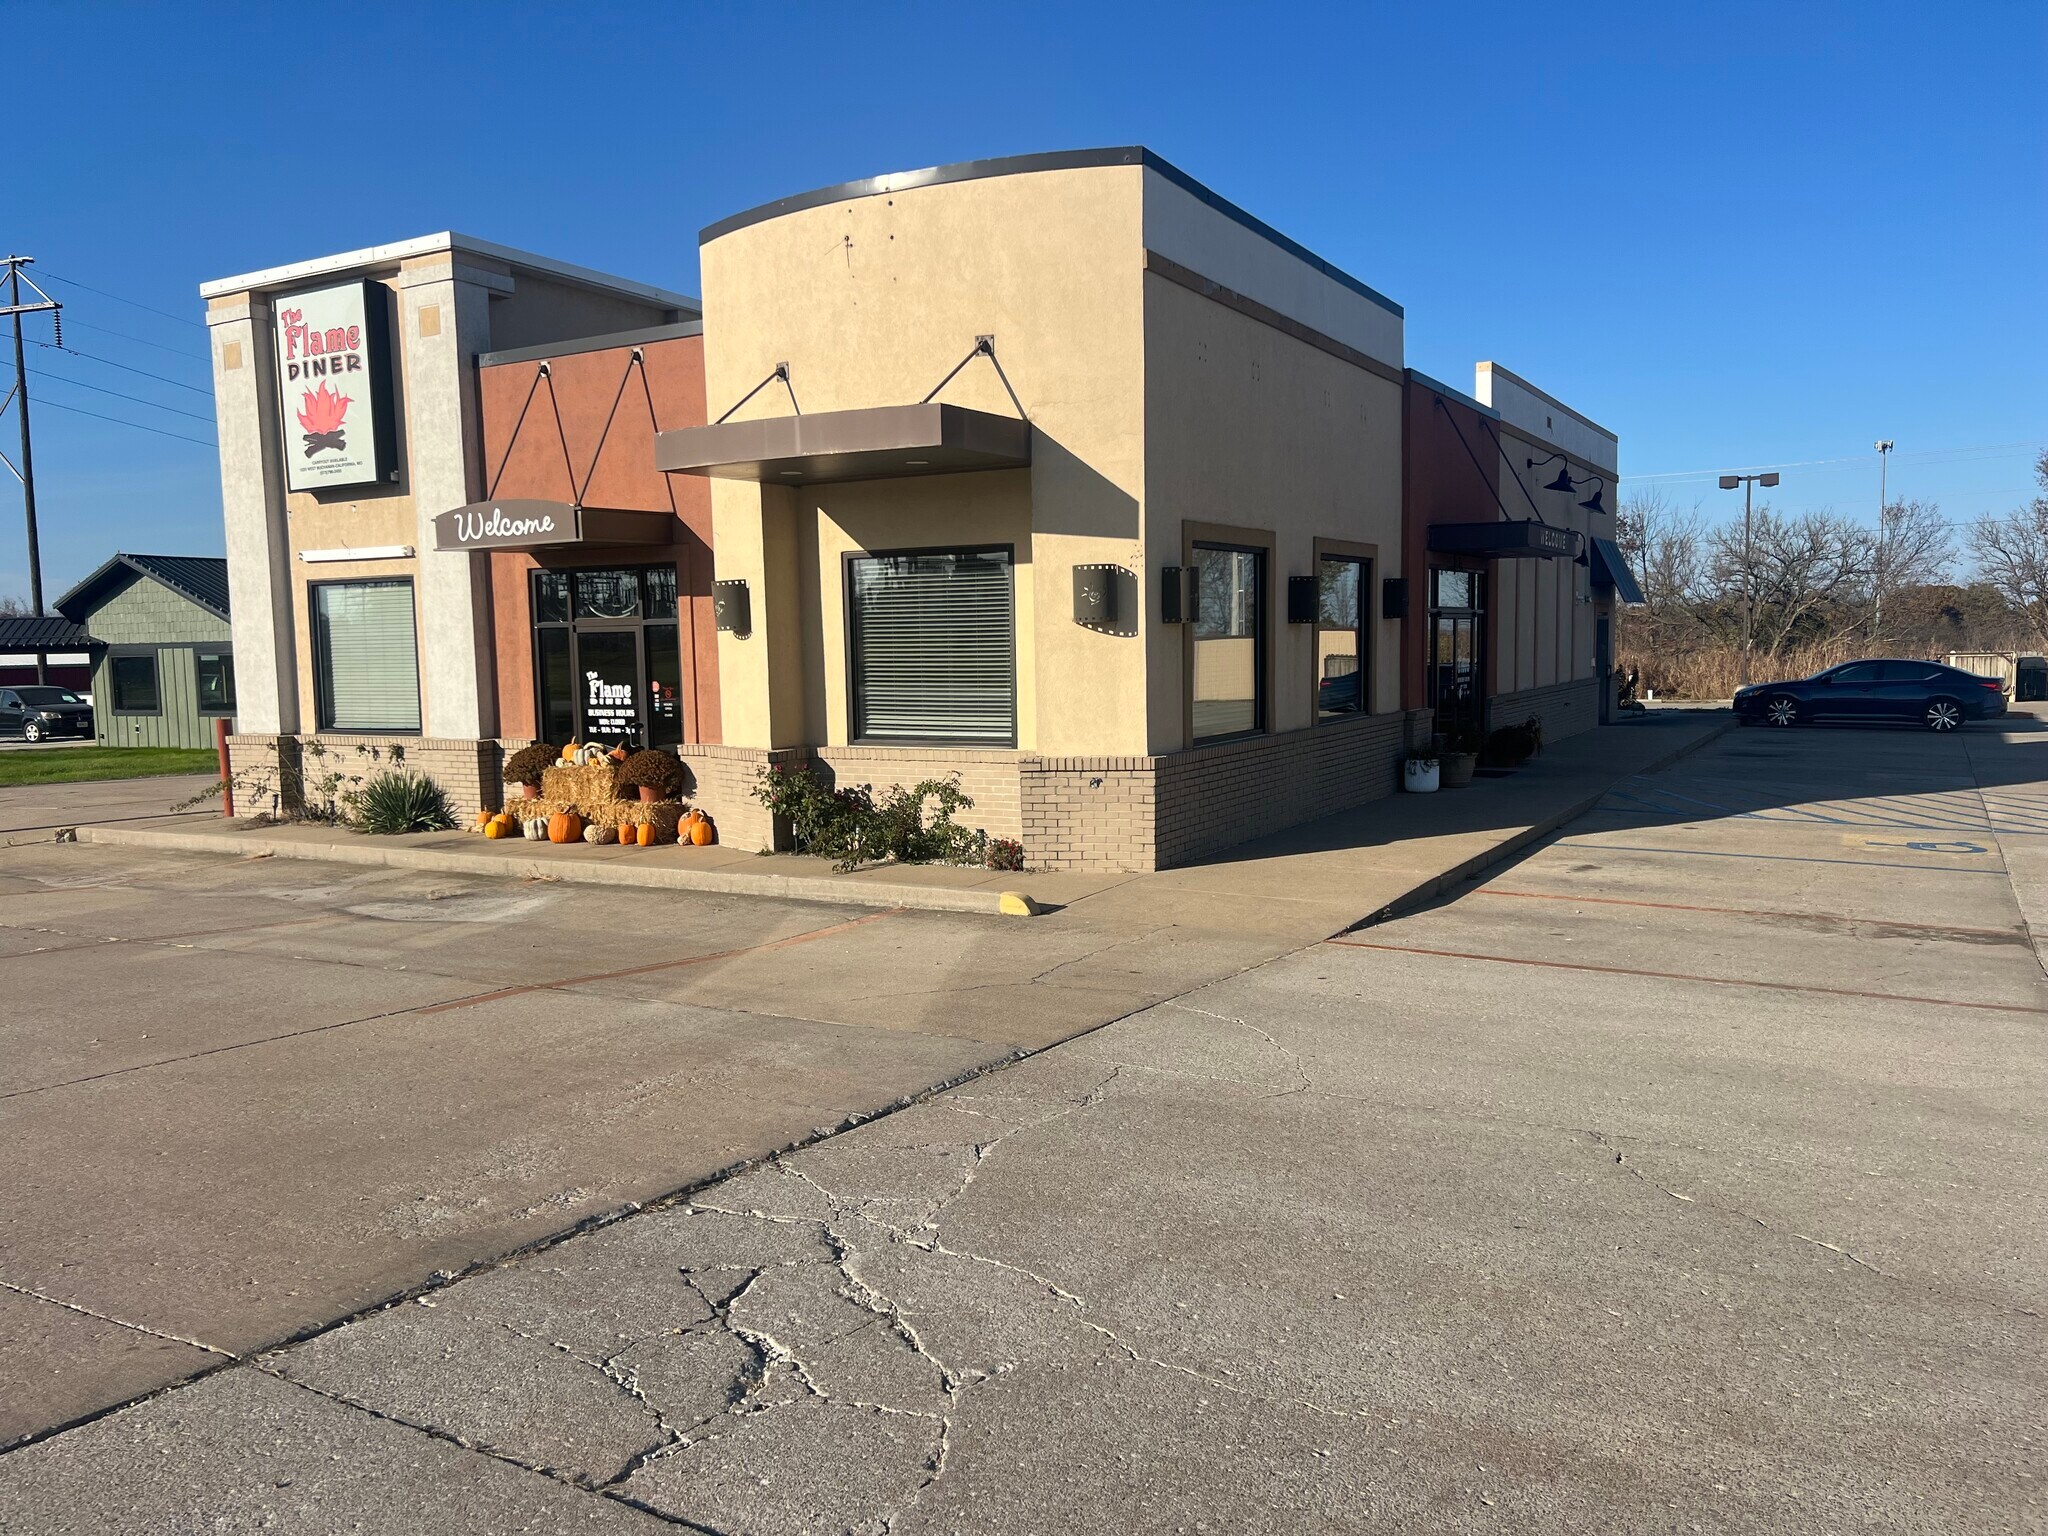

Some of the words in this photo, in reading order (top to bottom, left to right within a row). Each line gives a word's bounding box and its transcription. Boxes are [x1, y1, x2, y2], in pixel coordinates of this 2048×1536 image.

[281, 308, 302, 328] The
[285, 322, 361, 360] Flame
[288, 353, 362, 381] DINER
[453, 508, 555, 542] Welcome
[1540, 530, 1566, 550] WELCOME
[586, 671, 598, 681] The
[589, 679, 632, 698] Flame
[587, 709, 614, 717] BUSINESS
[616, 709, 635, 717] HOURS
